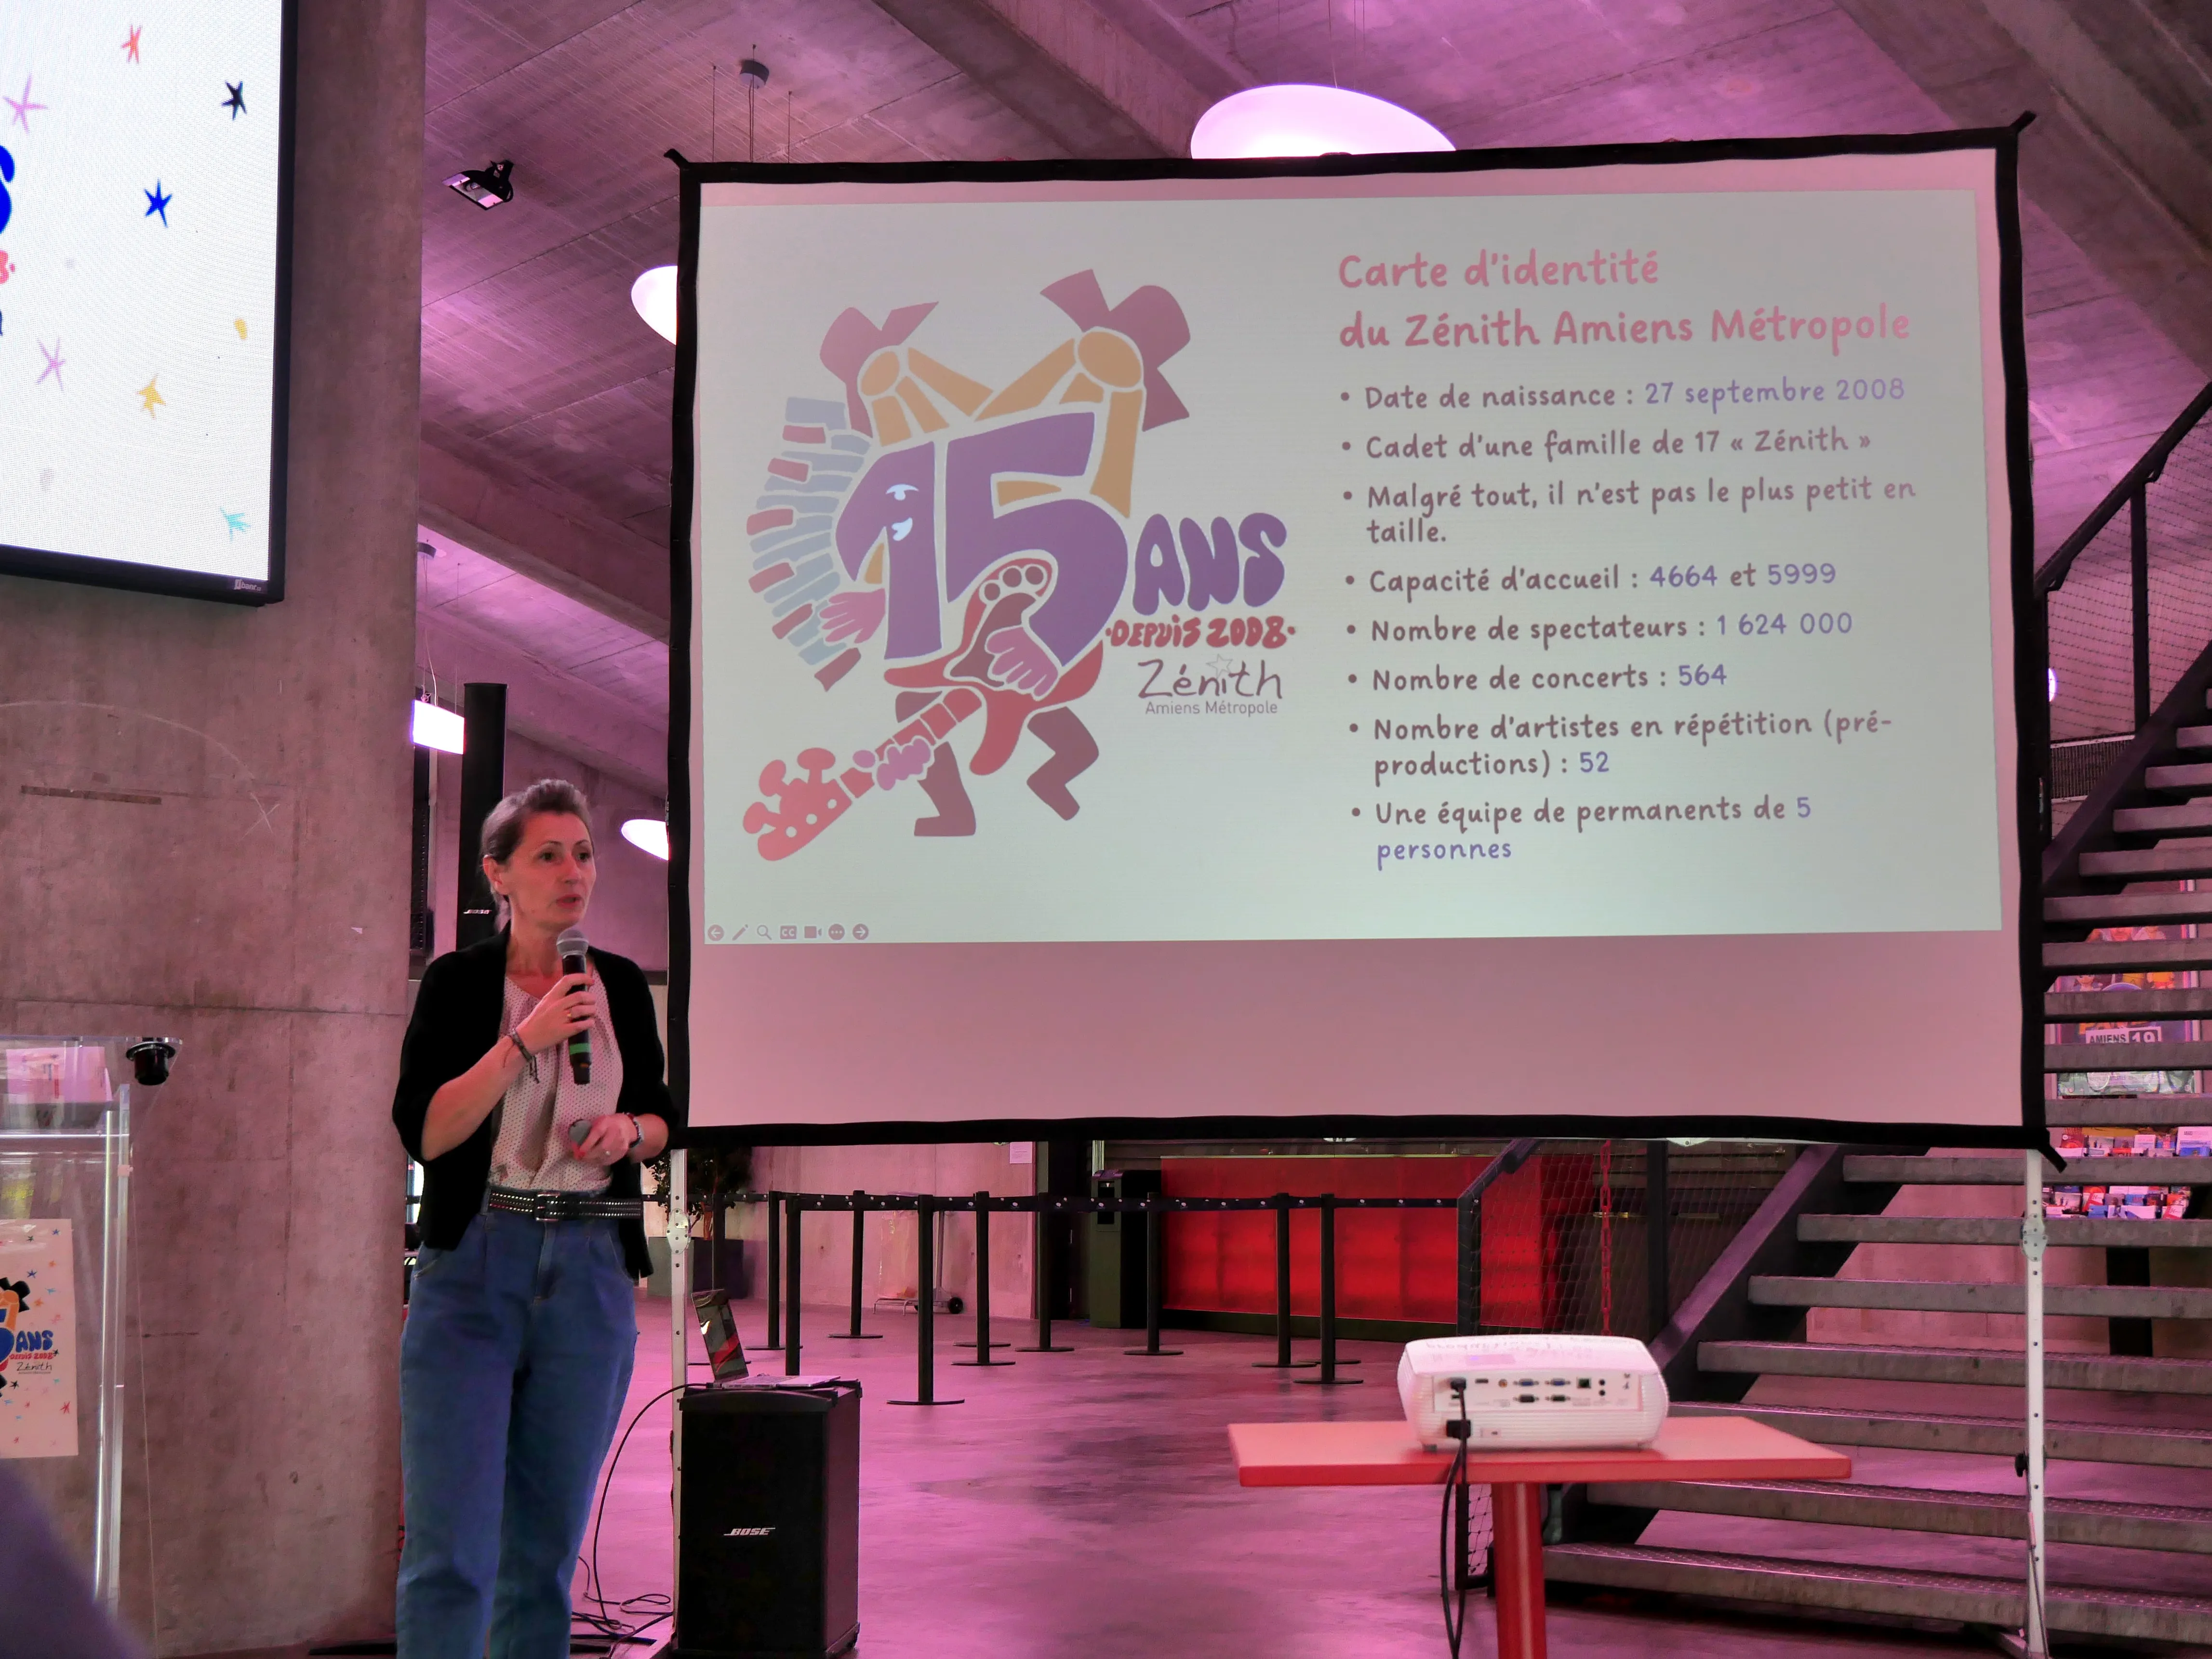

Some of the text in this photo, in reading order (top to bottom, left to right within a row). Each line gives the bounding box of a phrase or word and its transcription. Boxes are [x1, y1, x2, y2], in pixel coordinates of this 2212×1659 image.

[1338, 248, 1658, 289] Carte d'identité
[1339, 302, 1909, 357] du Zénith Amiens Métropole
[1365, 385, 1427, 410] Date
[1439, 383, 1470, 409] de
[1482, 385, 1615, 408] naissance
[1645, 381, 1674, 404] 27
[1685, 376, 1825, 414] septembre
[1837, 377, 1905, 400] 2008
[1366, 432, 1448, 459] Cadet
[1458, 431, 1533, 458] d'une
[1544, 429, 1640, 463] famille
[1652, 428, 1684, 455] de
[1695, 429, 1720, 452] 17
[1754, 425, 1849, 452] Zénith
[1368, 476, 1916, 518] Malgré tout, il n'est pas le plus petit en
[835, 411, 1128, 667] 15
[1366, 518, 1447, 544] taille.
[1132, 512, 1287, 615] ANS
[1369, 567, 1490, 604] Capacité
[1501, 563, 1619, 592] d'accueil
[1649, 564, 1718, 588] 4664
[1730, 562, 1757, 587] et
[1768, 562, 1836, 586] 5999
[1371, 614, 1477, 642] Nombre
[1487, 614, 1519, 641] de
[1530, 614, 1688, 651] spectateurs
[1717, 614, 1726, 636] 1
[1738, 612, 1787, 636] 624
[1800, 611, 1852, 635] 000
[1138, 659, 1282, 699] Zénith
[1373, 663, 1478, 691] Nombre
[1489, 664, 1520, 690] de
[1532, 664, 1649, 690] concerts
[1678, 663, 1727, 687] 564
[1146, 701, 1278, 717] Amiens Métropole
[1374, 708, 1892, 747] Nombre d'artistes en répétition (pré-
[1374, 749, 1551, 788] productions)
[1579, 750, 1610, 774] 52
[1375, 794, 1812, 835] Une équipe de permanents de 5
[1377, 842, 1512, 872] personnes
[2090, 1034, 2126, 1043] AMIENS
[16, 1330, 53, 1353] ANS
[724, 1527, 776, 1536] BOSE
